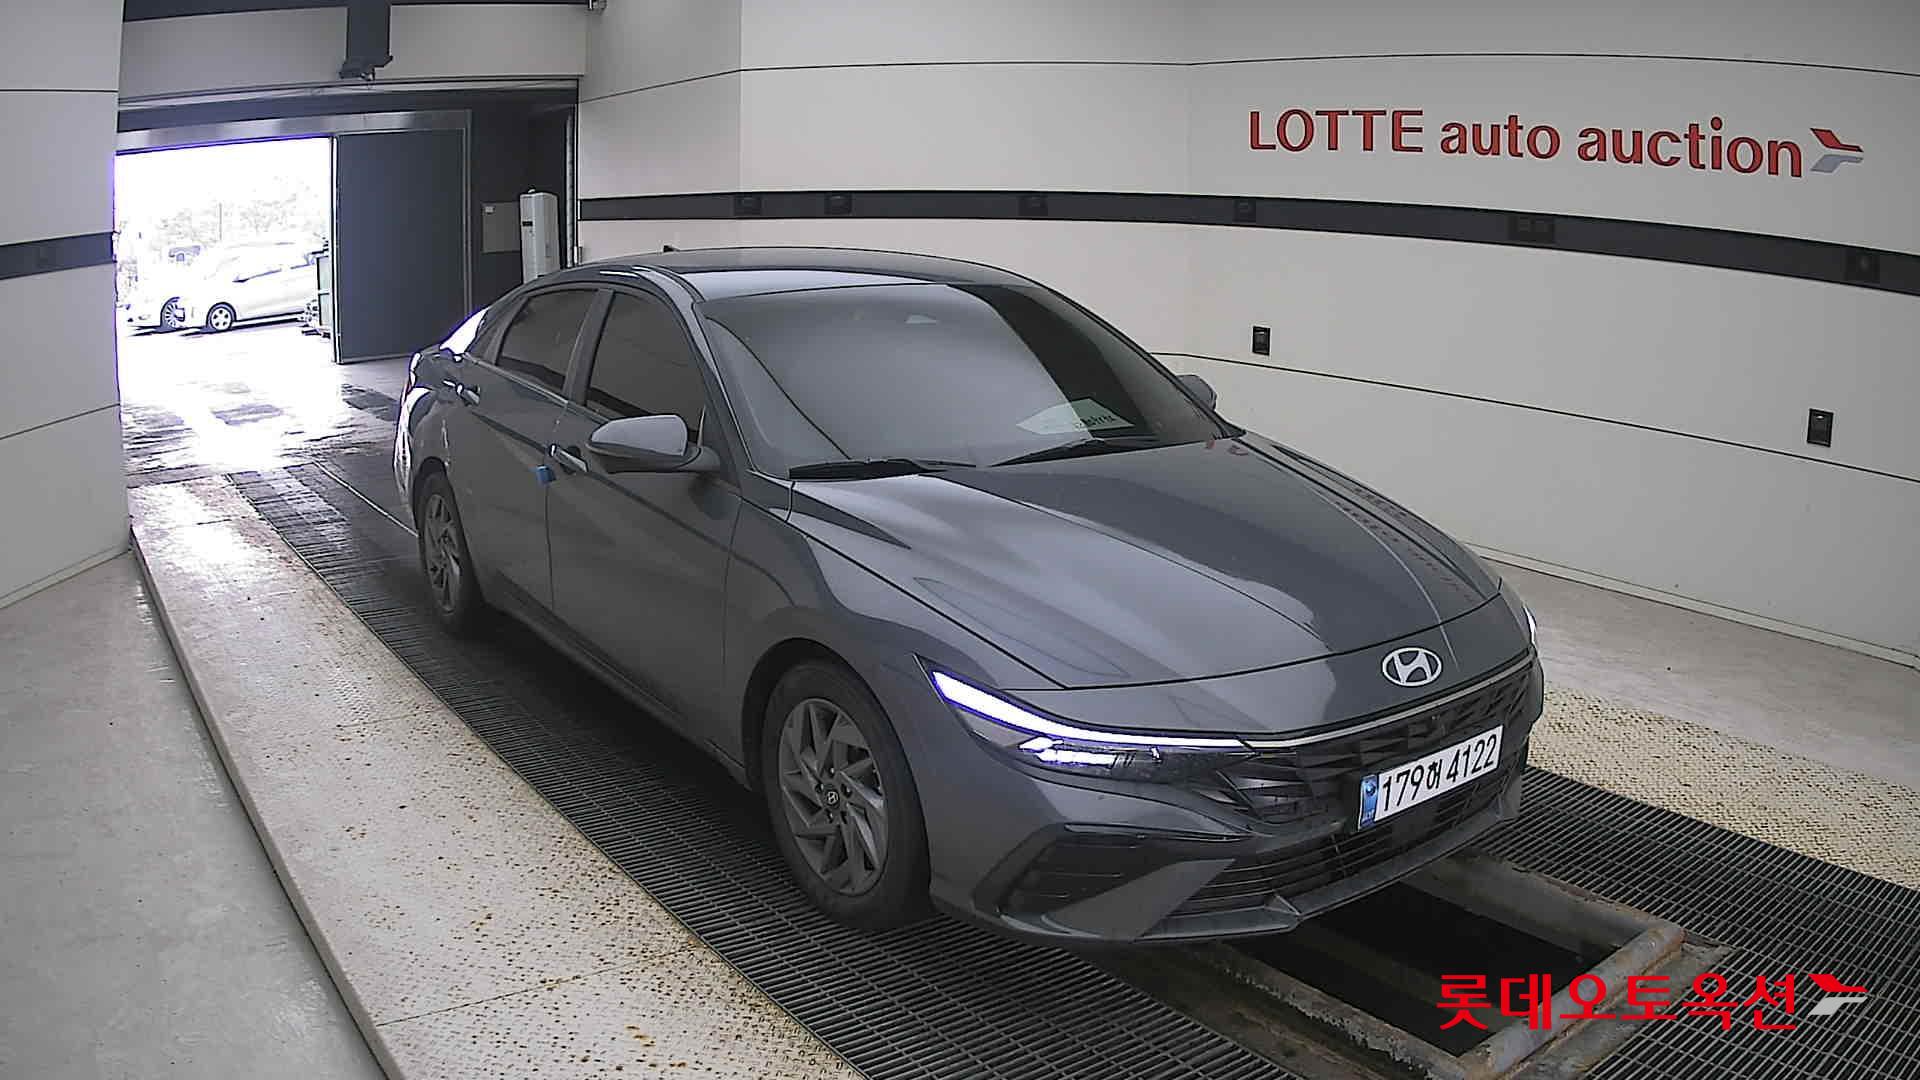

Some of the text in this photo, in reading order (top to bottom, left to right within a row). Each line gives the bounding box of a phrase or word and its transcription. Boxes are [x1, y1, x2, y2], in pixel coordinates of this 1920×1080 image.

[1249, 109, 1803, 179] LOTTE auto auction
[1382, 734, 1498, 812] 179허 4122
